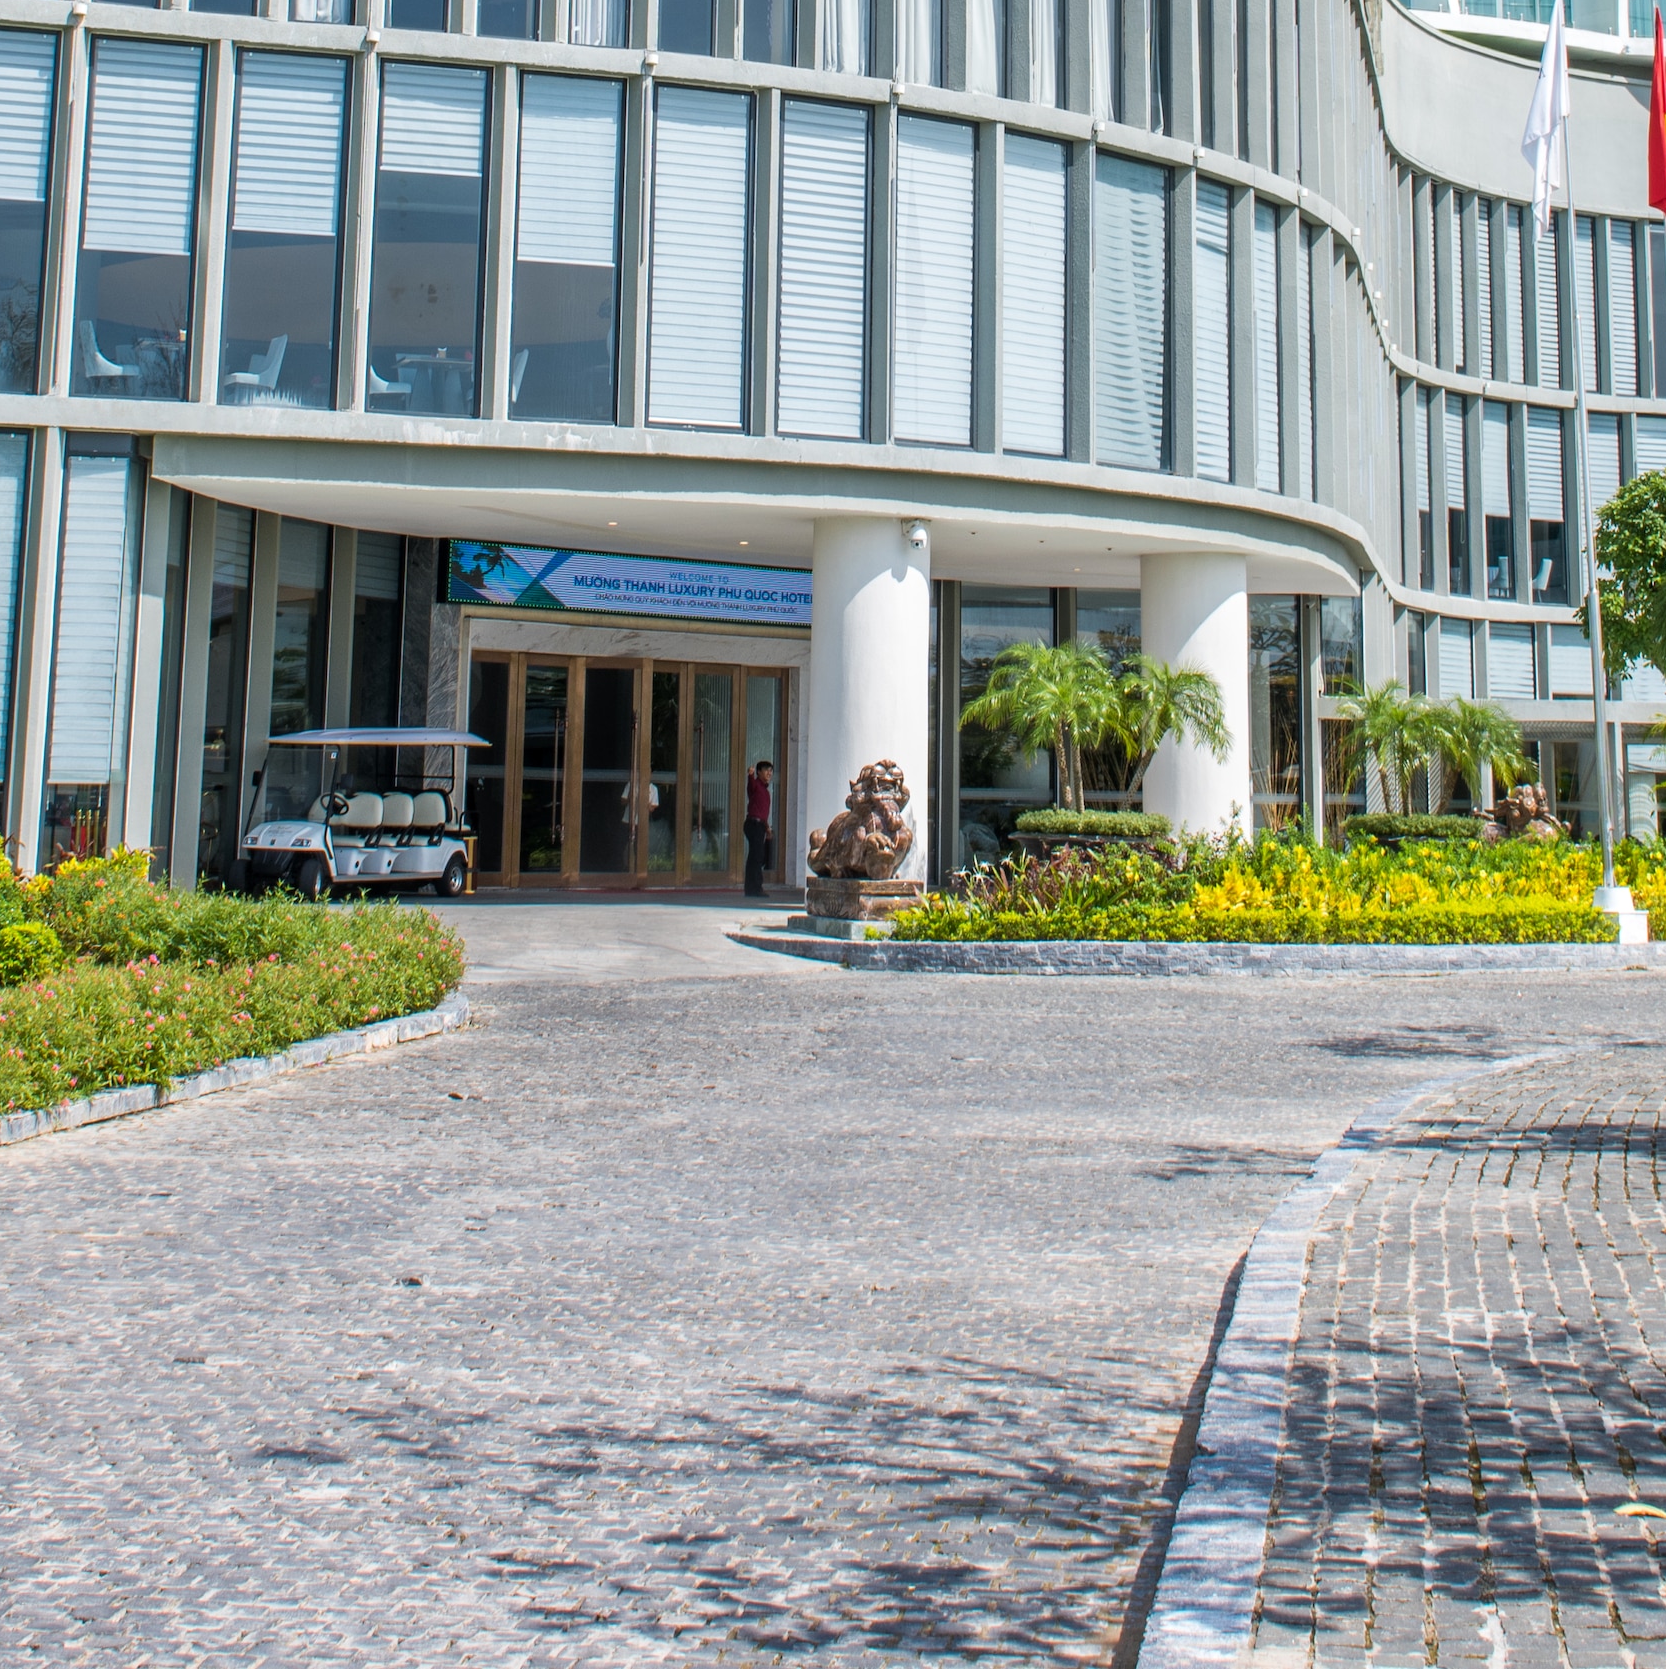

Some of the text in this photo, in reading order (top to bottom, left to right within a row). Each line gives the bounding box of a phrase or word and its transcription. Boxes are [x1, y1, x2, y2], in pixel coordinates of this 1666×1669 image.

[670, 572, 729, 584] WELCOME TO
[624, 580, 665, 592] THANH
[668, 583, 715, 596] LUXURY
